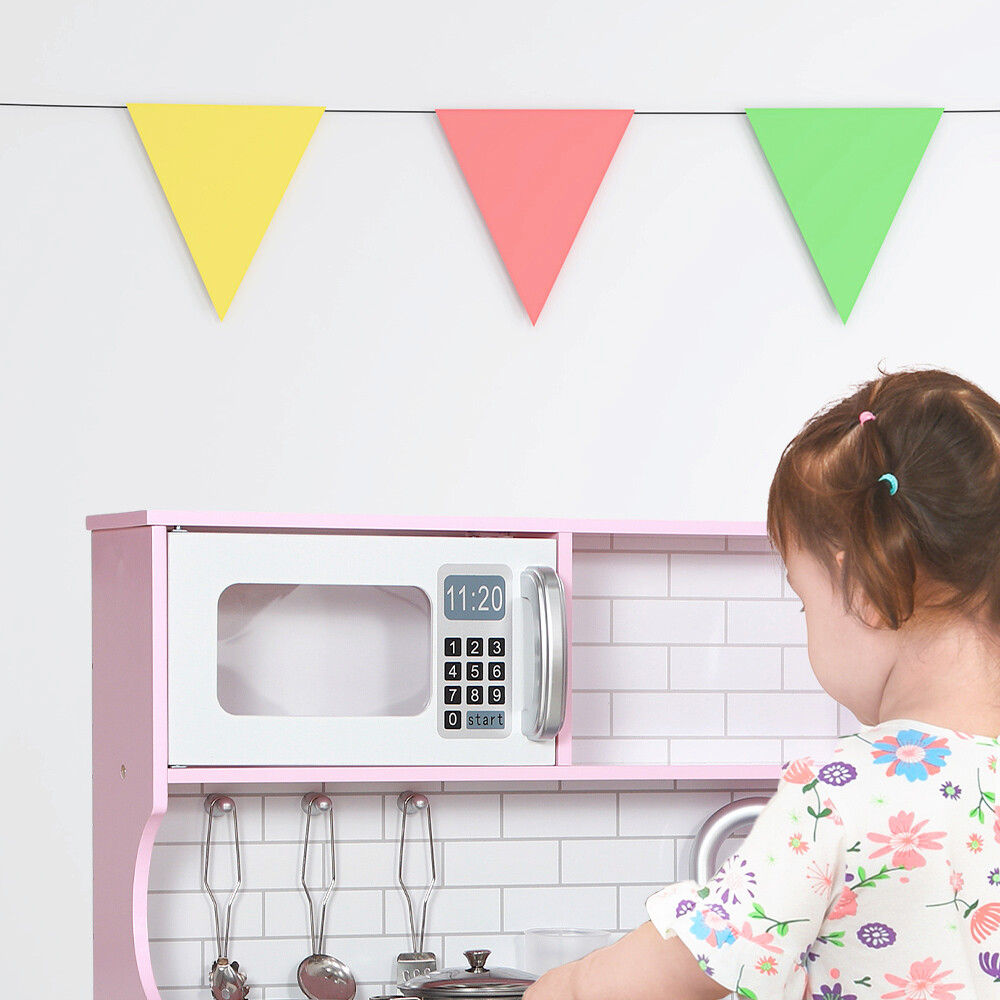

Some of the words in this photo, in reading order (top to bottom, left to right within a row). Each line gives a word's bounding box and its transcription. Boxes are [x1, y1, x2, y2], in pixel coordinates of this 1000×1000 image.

[446, 585, 503, 611] 11:20
[449, 640, 457, 654] 1
[470, 640, 480, 654] 2
[492, 640, 502, 654] 3
[448, 664, 458, 678] 4
[470, 664, 480, 678] 5
[492, 664, 502, 678] 6
[448, 688, 458, 702] 7
[470, 688, 480, 702] 8
[492, 688, 502, 702] 9
[448, 712, 458, 726] 0
[468, 713, 504, 726] start
